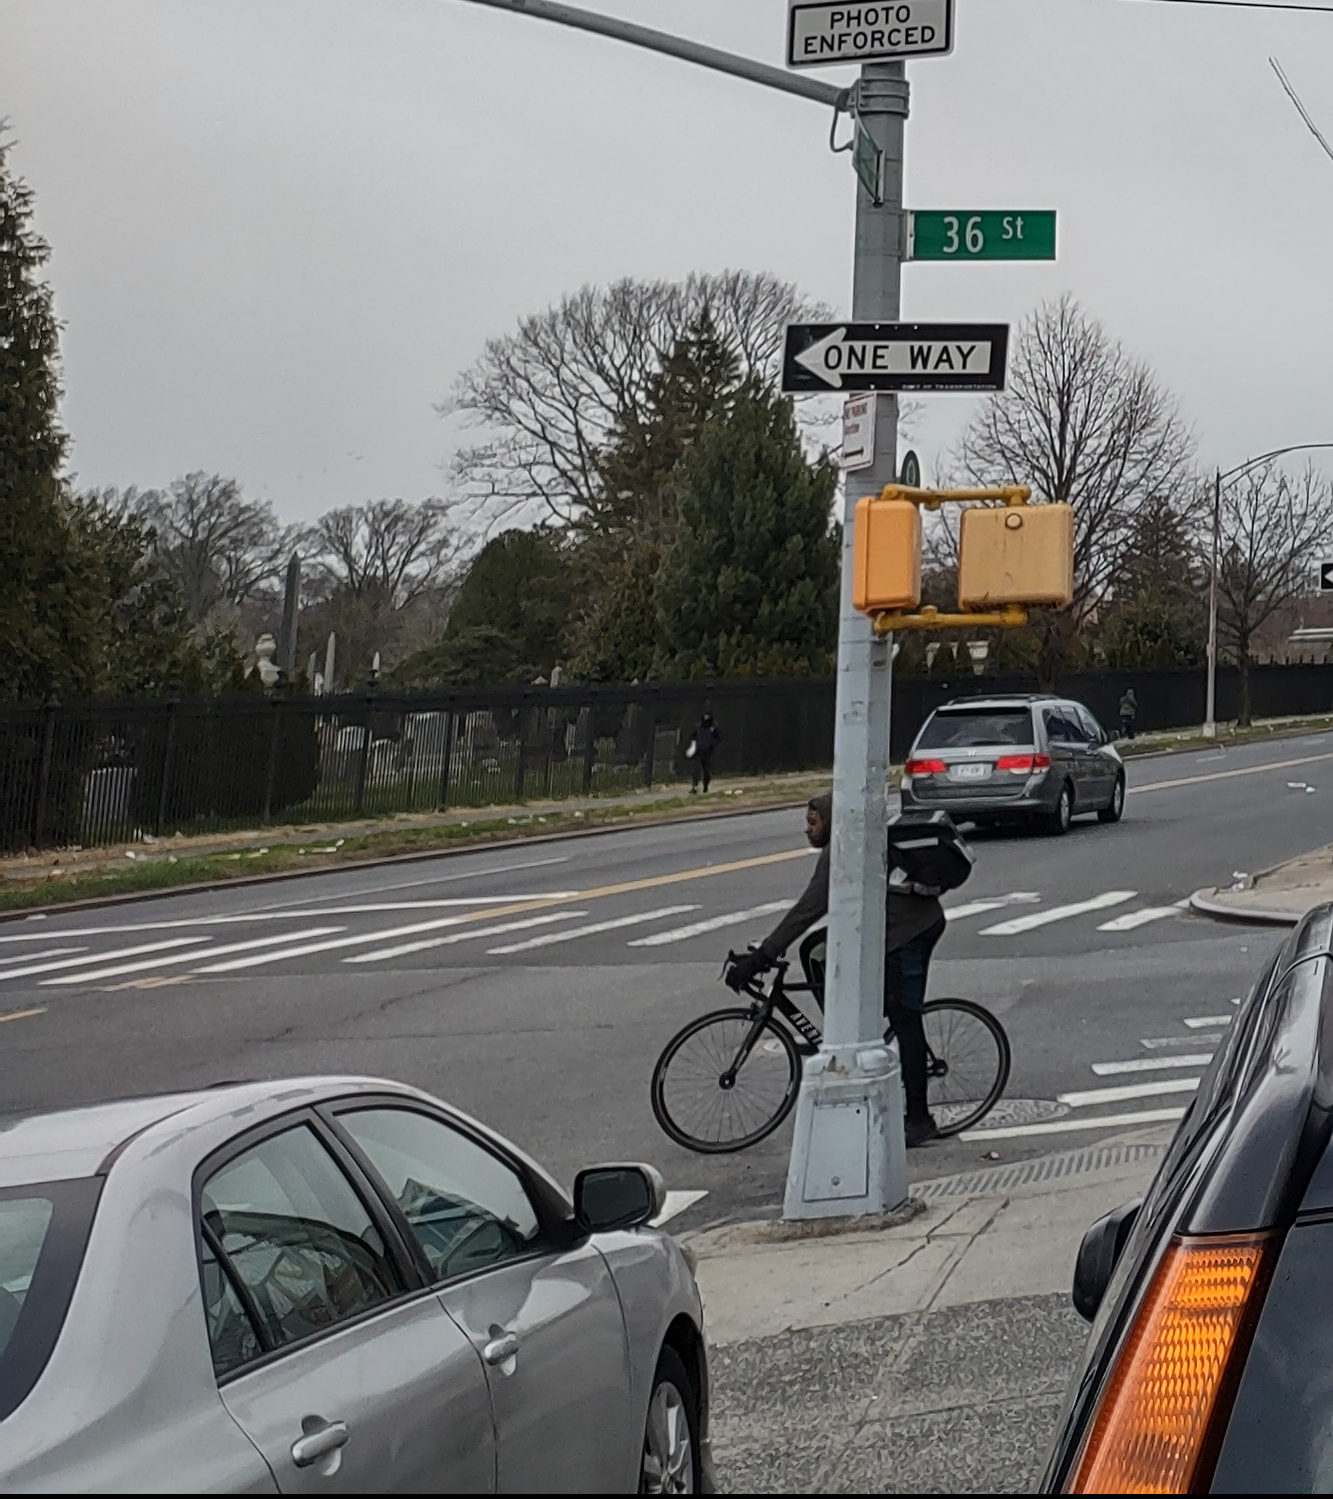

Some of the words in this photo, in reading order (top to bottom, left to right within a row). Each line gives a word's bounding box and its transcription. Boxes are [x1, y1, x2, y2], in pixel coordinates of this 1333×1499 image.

[830, 5, 910, 30] PHOTO
[803, 26, 936, 55] ENFORCED
[942, 216, 985, 253] 36
[1002, 216, 1024, 240] St
[823, 344, 890, 370] ONE
[908, 344, 977, 370] WAY
